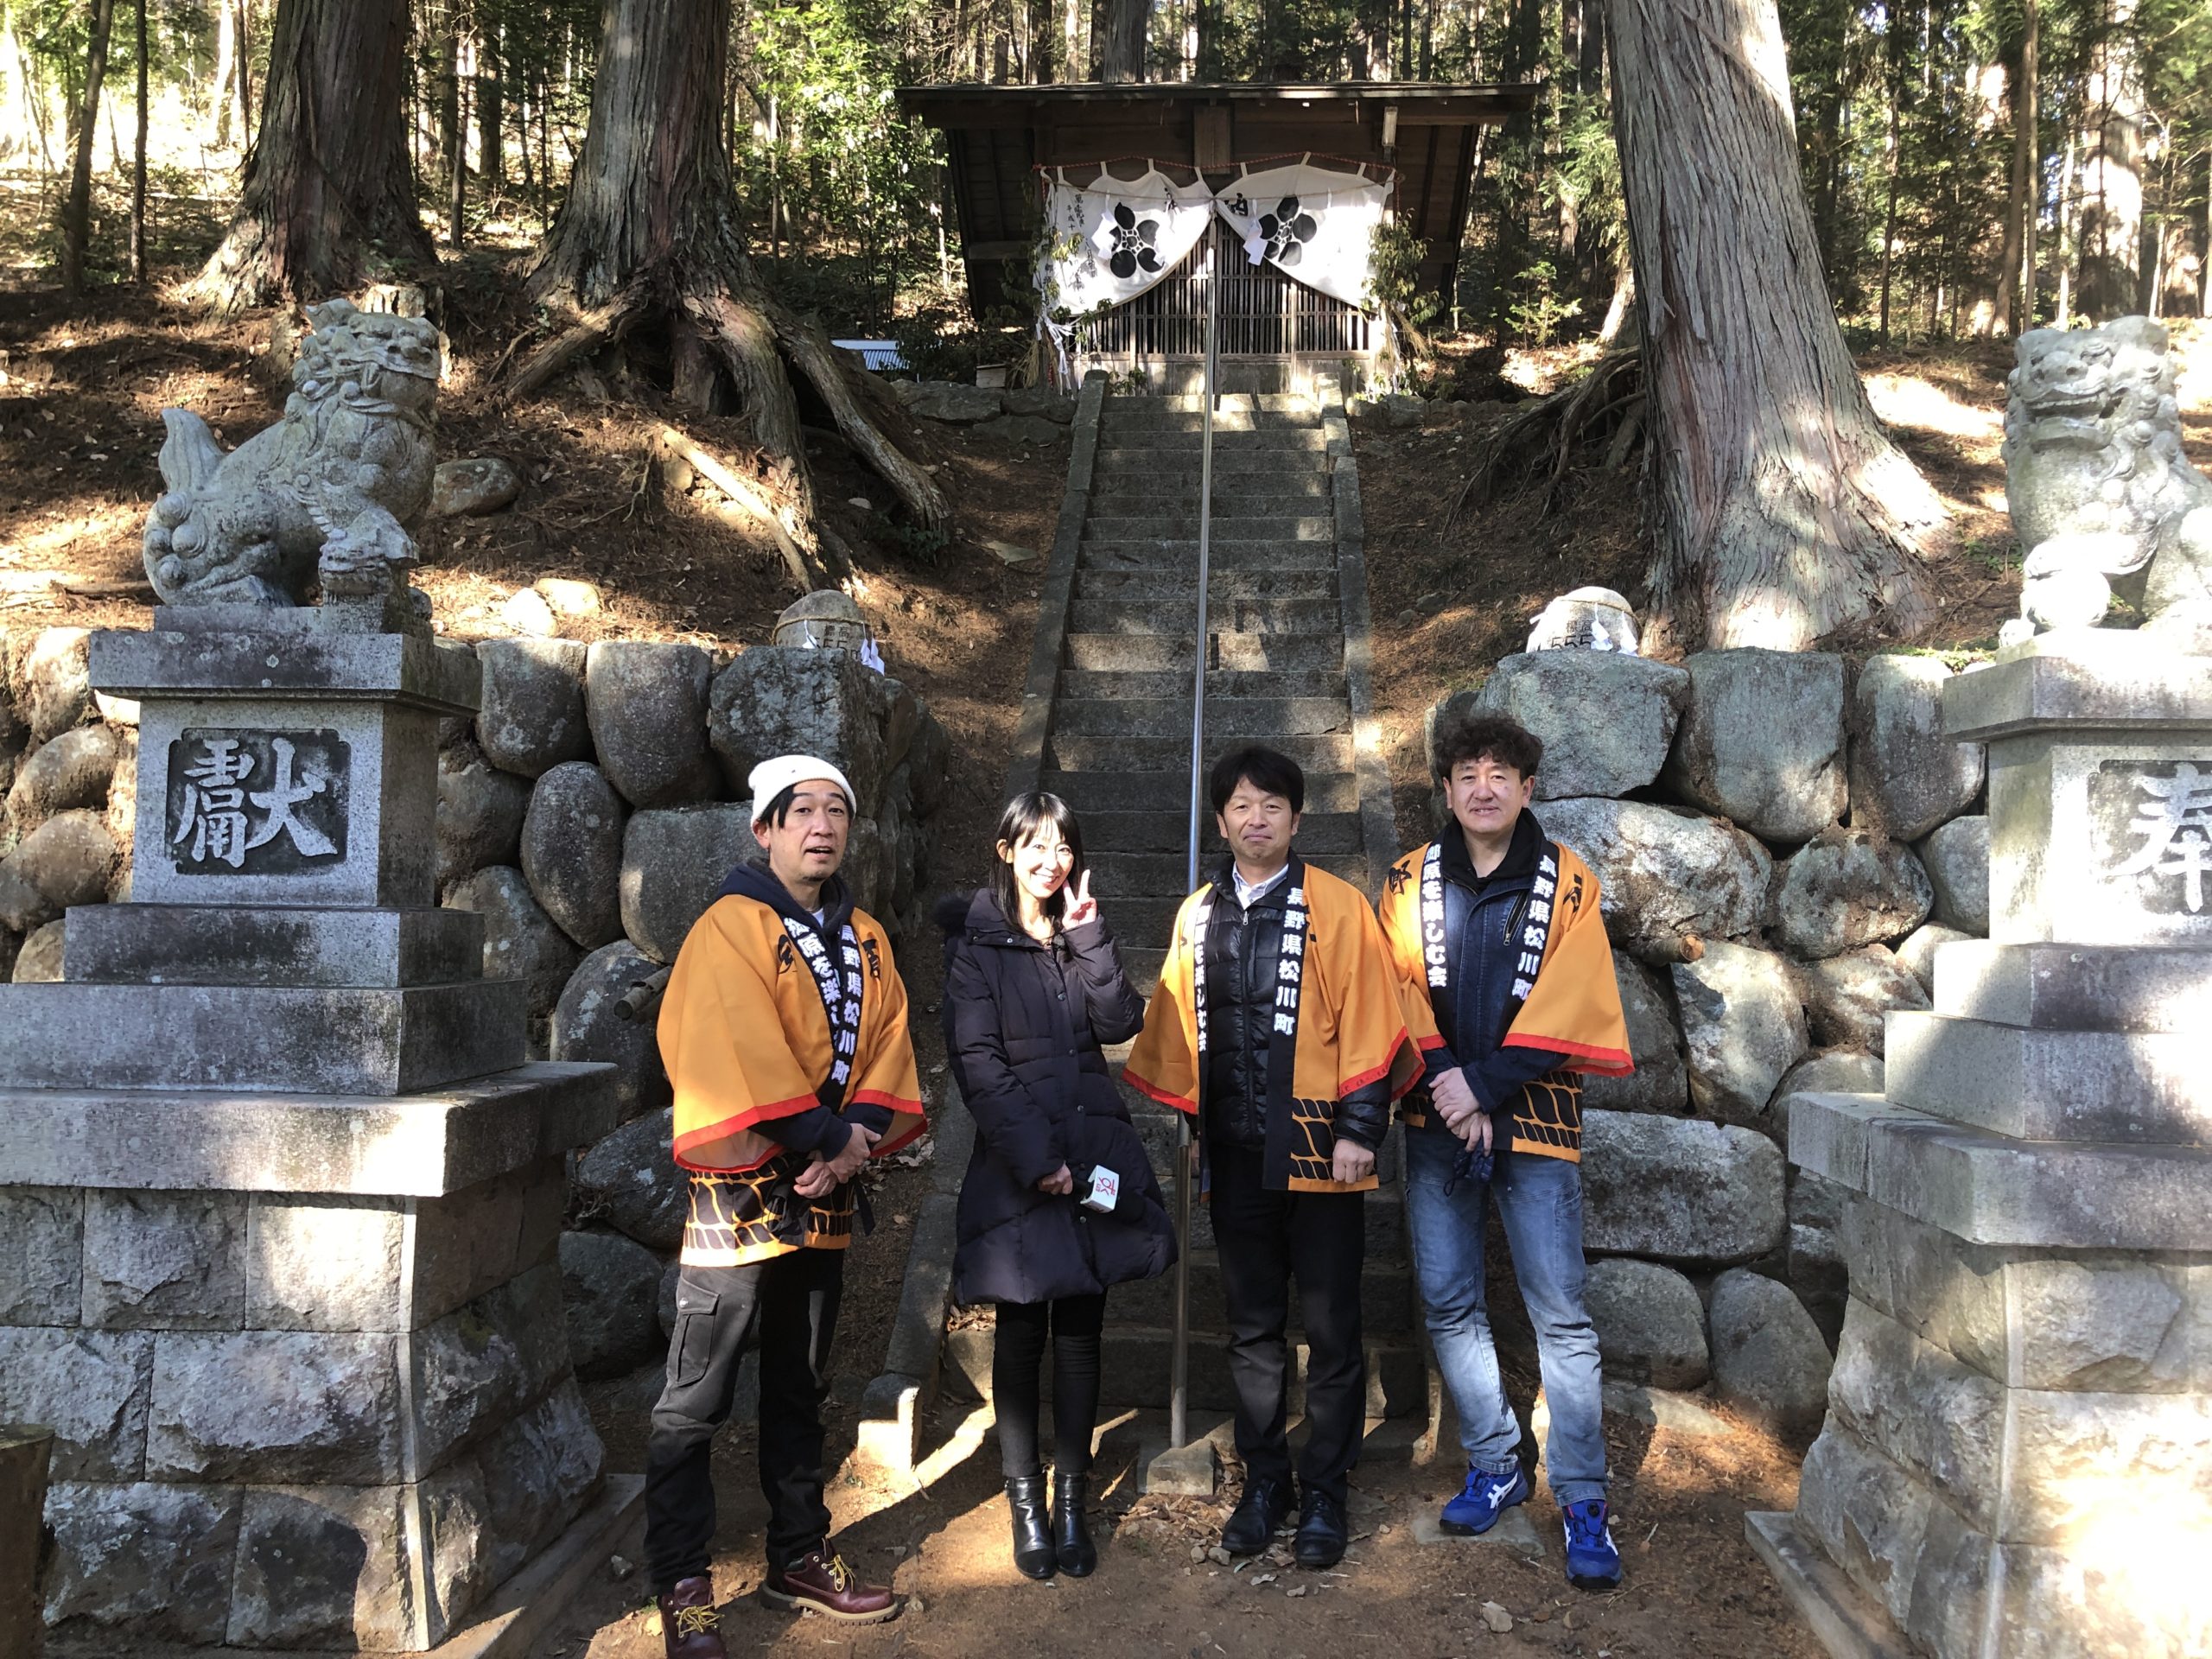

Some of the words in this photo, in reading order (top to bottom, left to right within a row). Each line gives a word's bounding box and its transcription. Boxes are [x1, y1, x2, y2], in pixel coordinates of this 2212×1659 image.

[1274, 887, 1306, 1036] 長野県松川町
[1512, 855, 1557, 1001] 長野県松川町
[830, 925, 863, 1086] 長野県松川町
